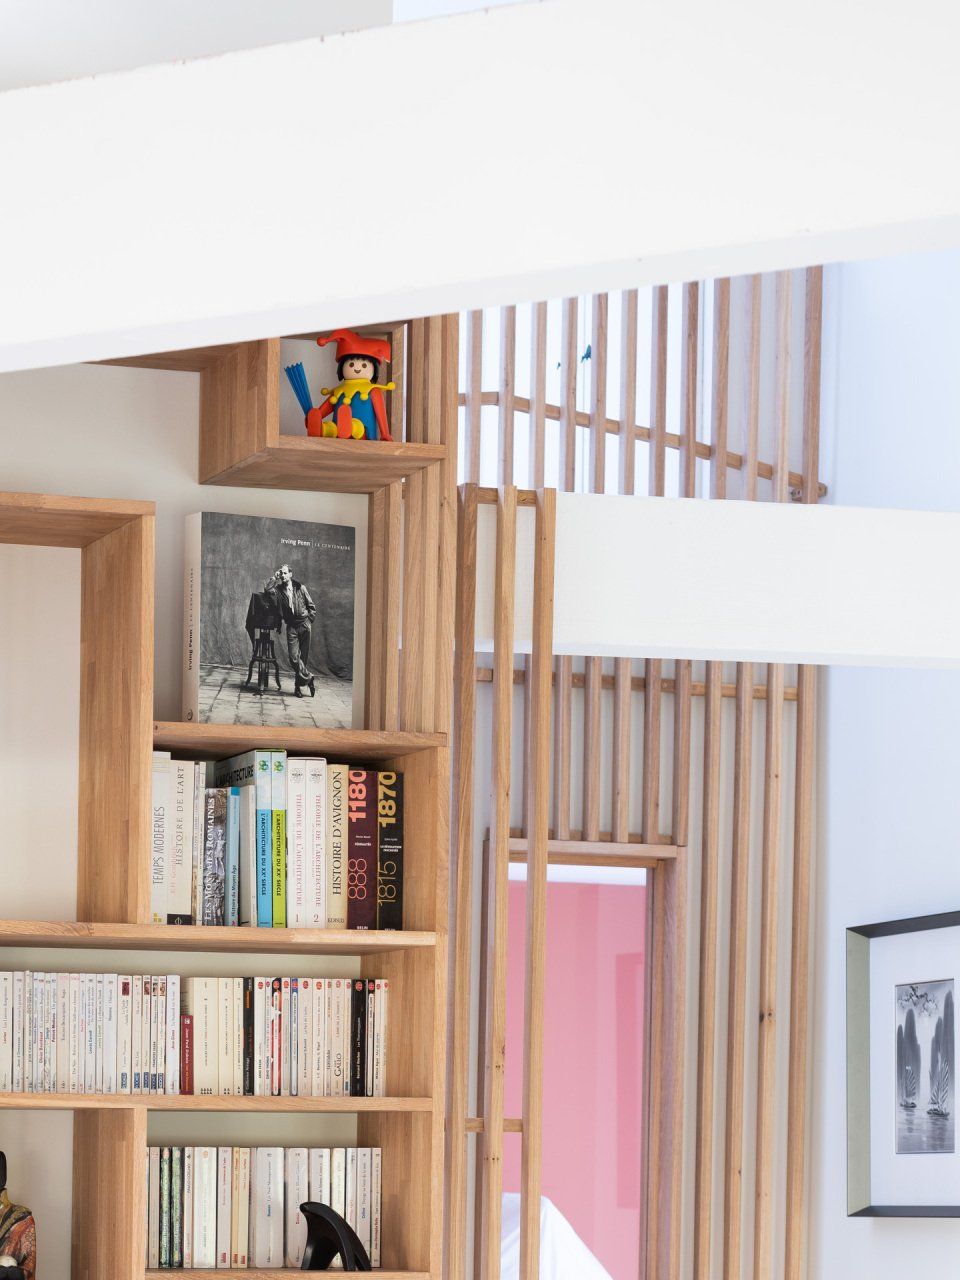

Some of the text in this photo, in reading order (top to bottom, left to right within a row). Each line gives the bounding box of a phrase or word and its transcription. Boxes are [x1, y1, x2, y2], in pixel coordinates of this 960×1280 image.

[177, 799, 184, 812] DE
[348, 770, 367, 823] 1180
[379, 772, 396, 828] 1870
[153, 806, 165, 884] TEMPS MODERNES
[316, 830, 322, 841] DE
[332, 772, 342, 896] HISTOIRE D'AVIGNON
[204, 798, 215, 920] LES MONNAIES ROMAINES
[348, 858, 367, 900] 888
[378, 861, 396, 906] 1815
[313, 915, 320, 923] 2
